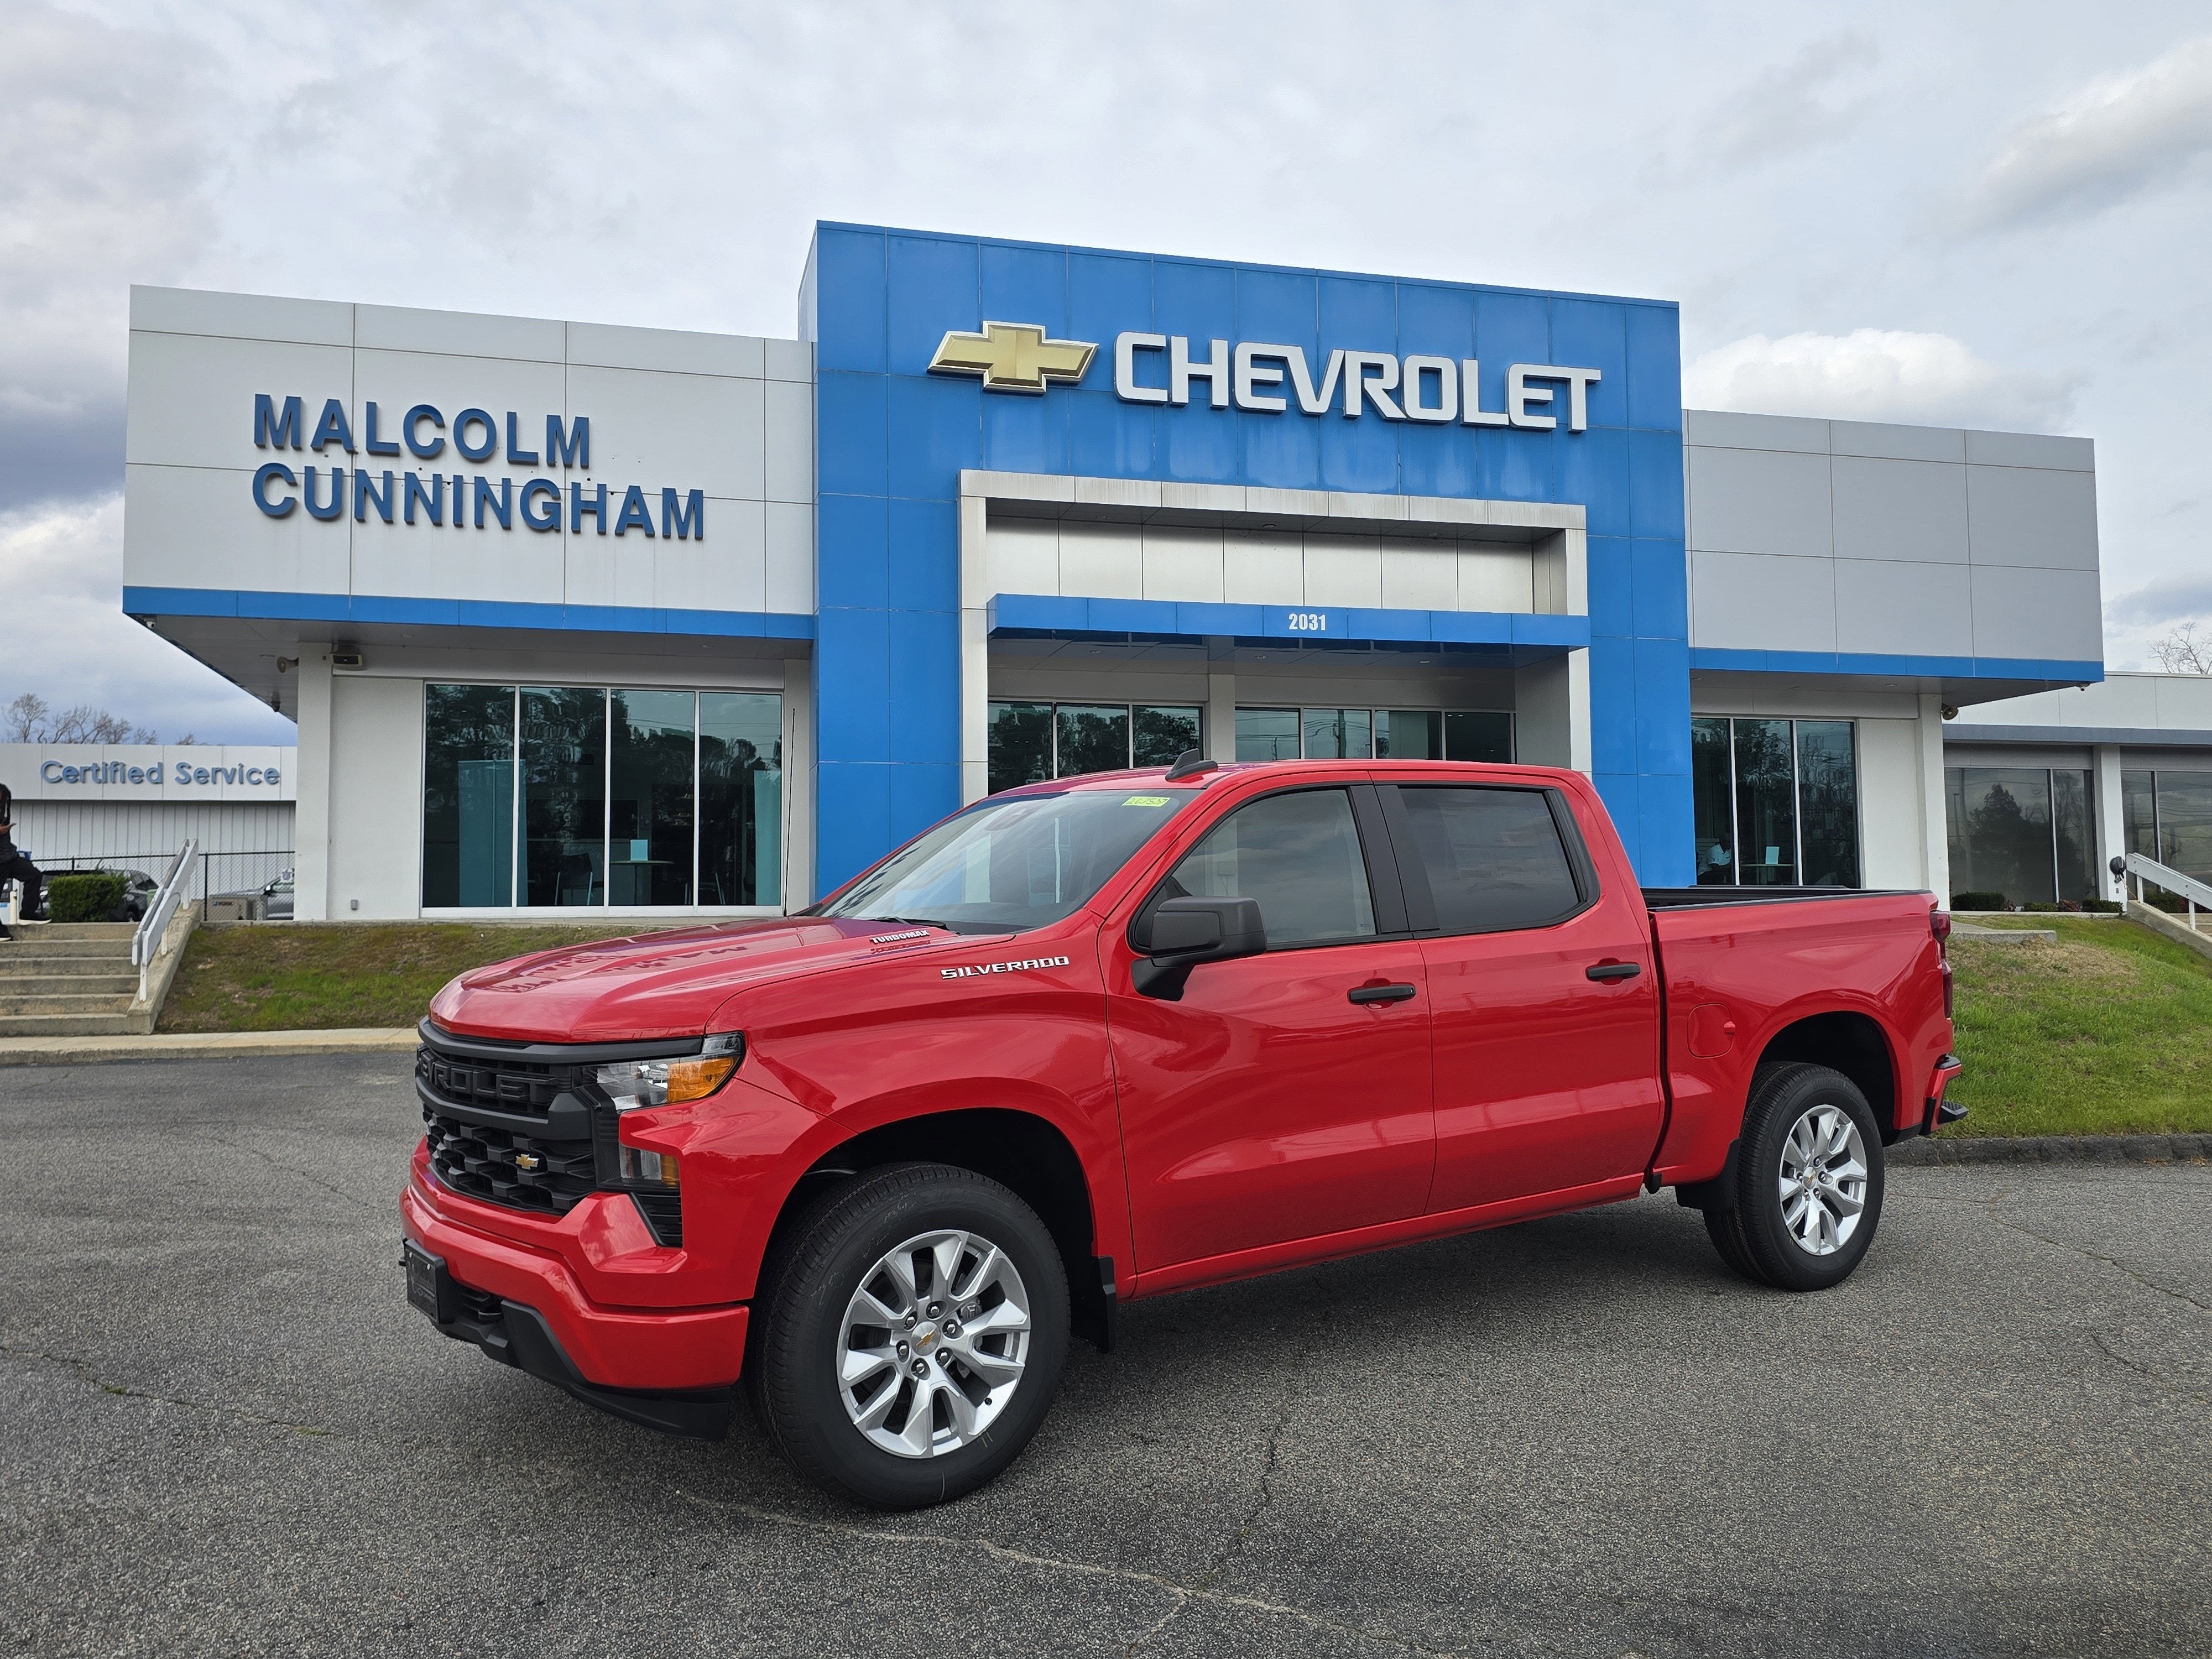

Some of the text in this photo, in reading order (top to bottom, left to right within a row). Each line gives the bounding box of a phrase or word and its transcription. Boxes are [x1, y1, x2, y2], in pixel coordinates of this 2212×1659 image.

[1113, 331, 1601, 432] CHEVROLET
[254, 393, 589, 468] MALCOLM
[252, 462, 704, 541] CUNNINGHAM
[1288, 613, 1326, 630] 2031
[40, 760, 281, 785] Certified Service
[869, 930, 931, 945] TURBOMAX
[940, 956, 1070, 980] SILVERADO
